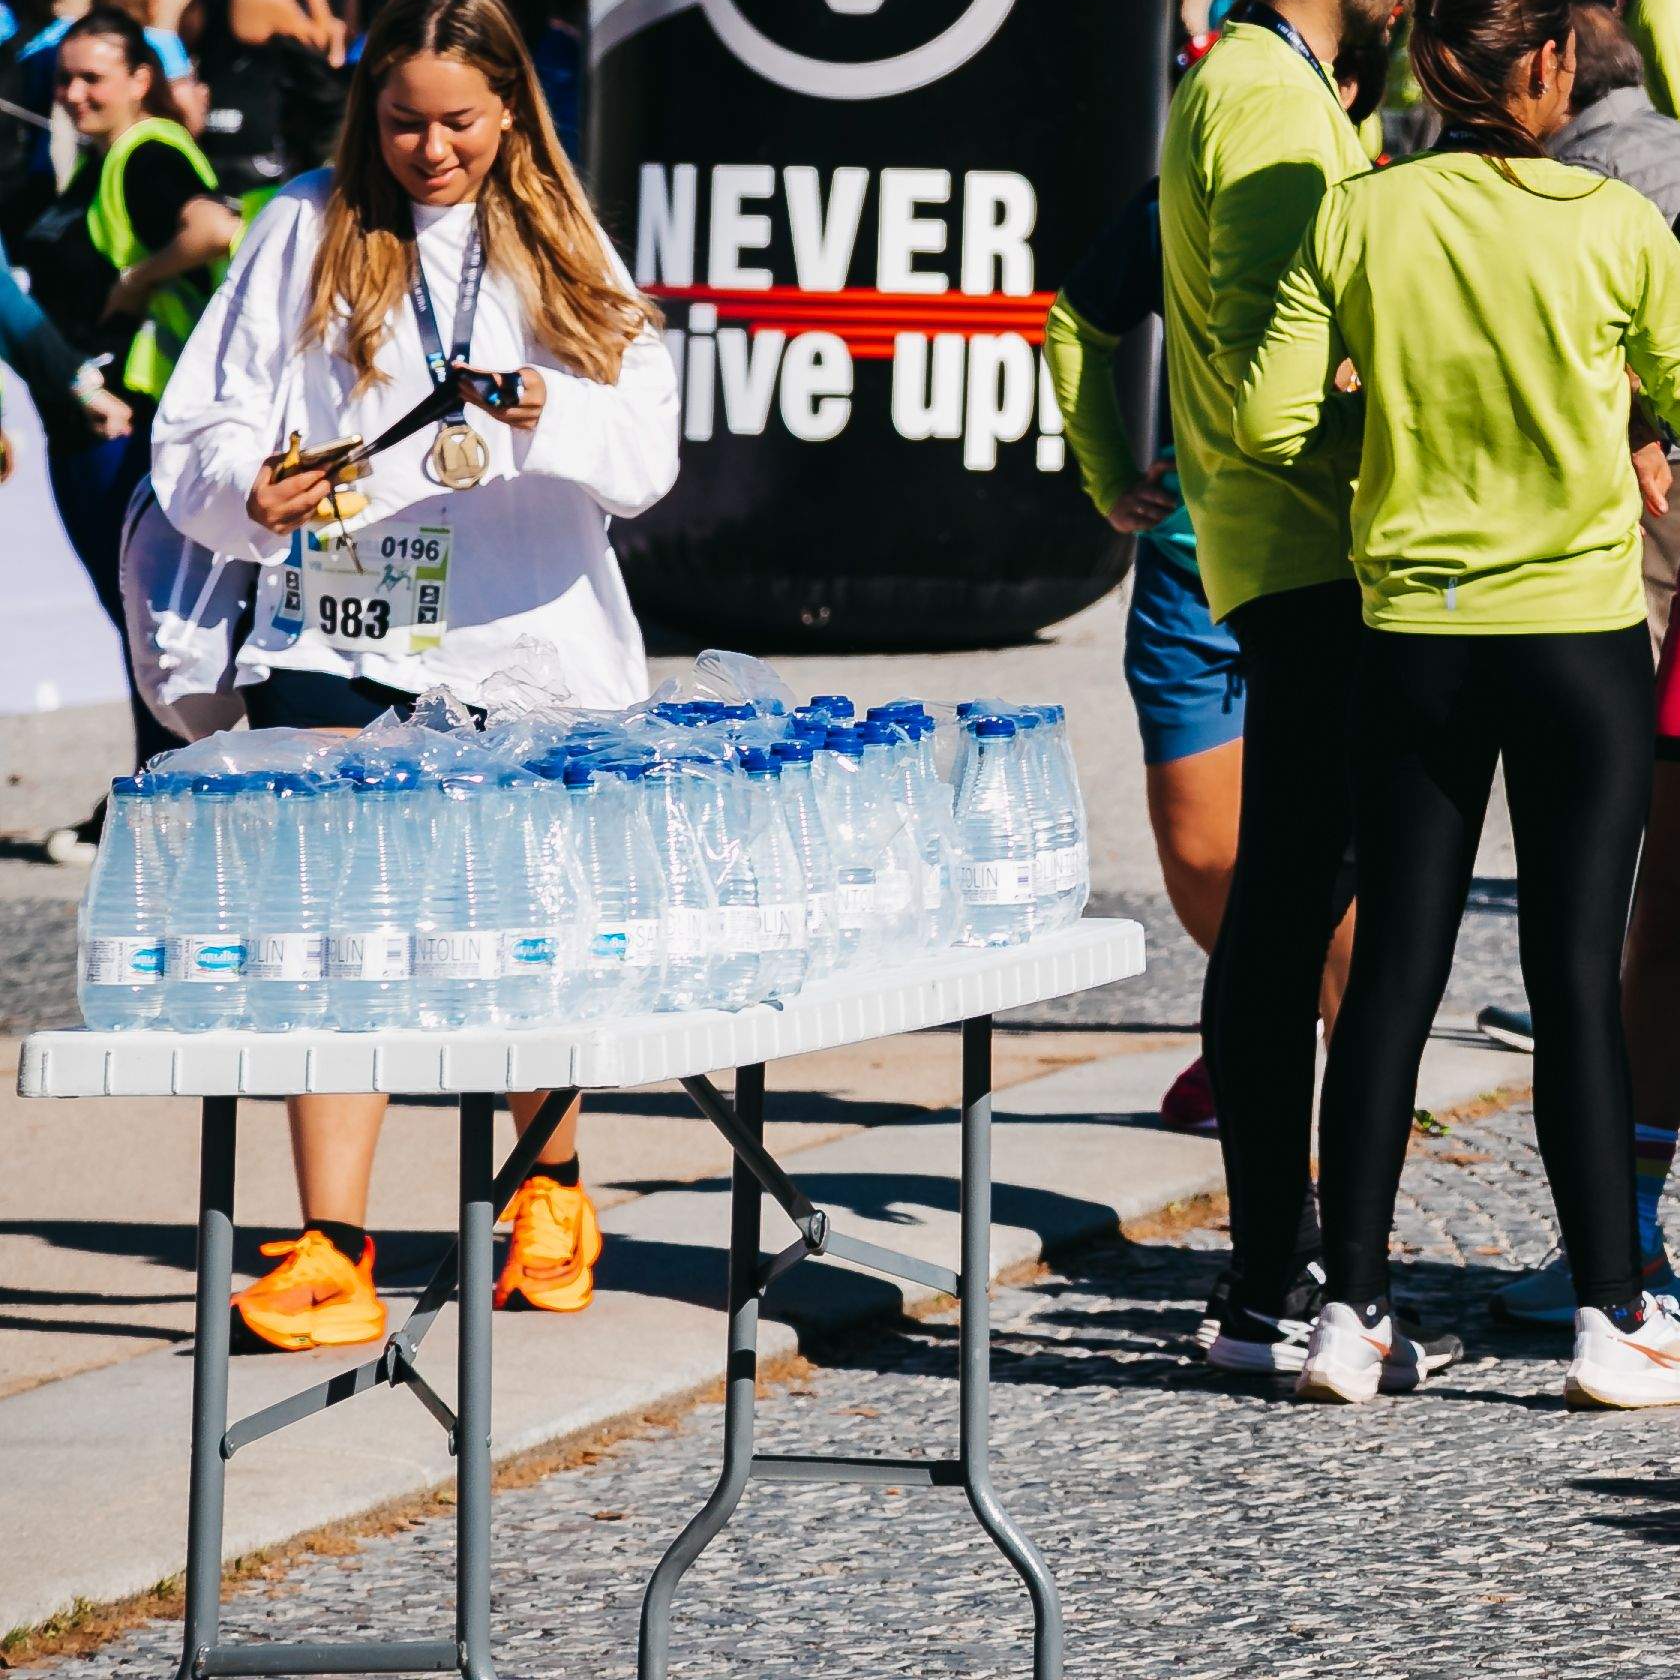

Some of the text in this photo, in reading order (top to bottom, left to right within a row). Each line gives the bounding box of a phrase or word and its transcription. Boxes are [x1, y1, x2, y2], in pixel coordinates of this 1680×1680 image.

[636, 161, 1038, 297] NEVER
[667, 302, 1068, 472] ive up!
[380, 535, 440, 562] 0196
[319, 594, 391, 640] 983
